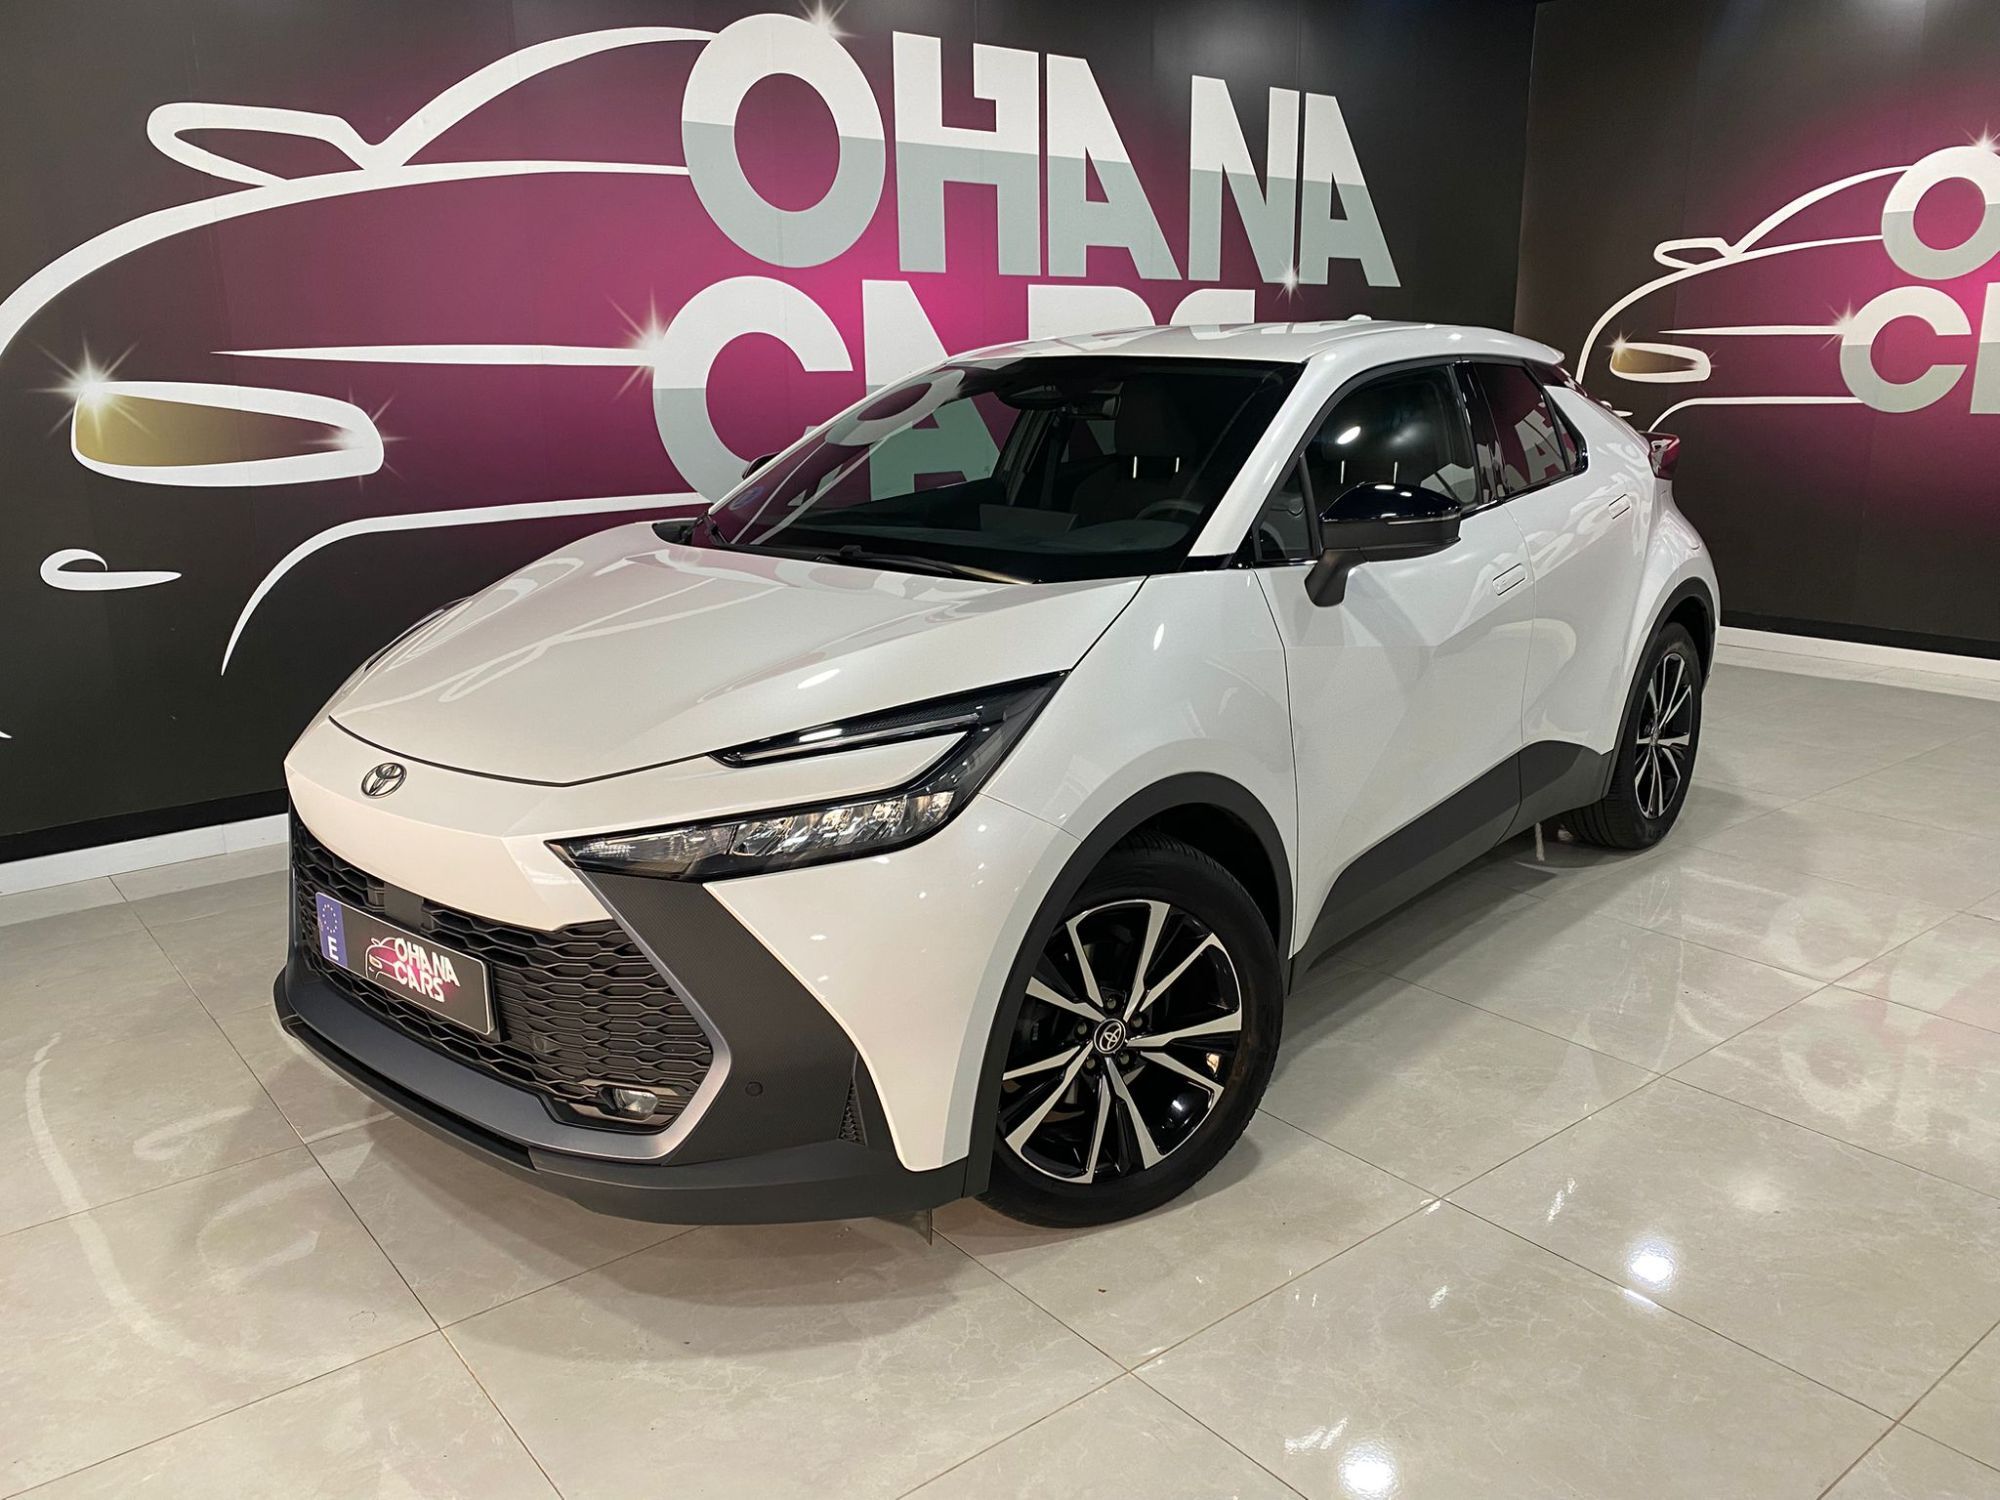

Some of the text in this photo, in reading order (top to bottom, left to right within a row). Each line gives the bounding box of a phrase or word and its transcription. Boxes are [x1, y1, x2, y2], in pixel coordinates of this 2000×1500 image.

[682, 13, 1401, 287] OHANA
[652, 275, 1256, 502] CA
[327, 935, 339, 961] E
[394, 937, 460, 987] OHANA
[393, 960, 445, 1003] CARS
